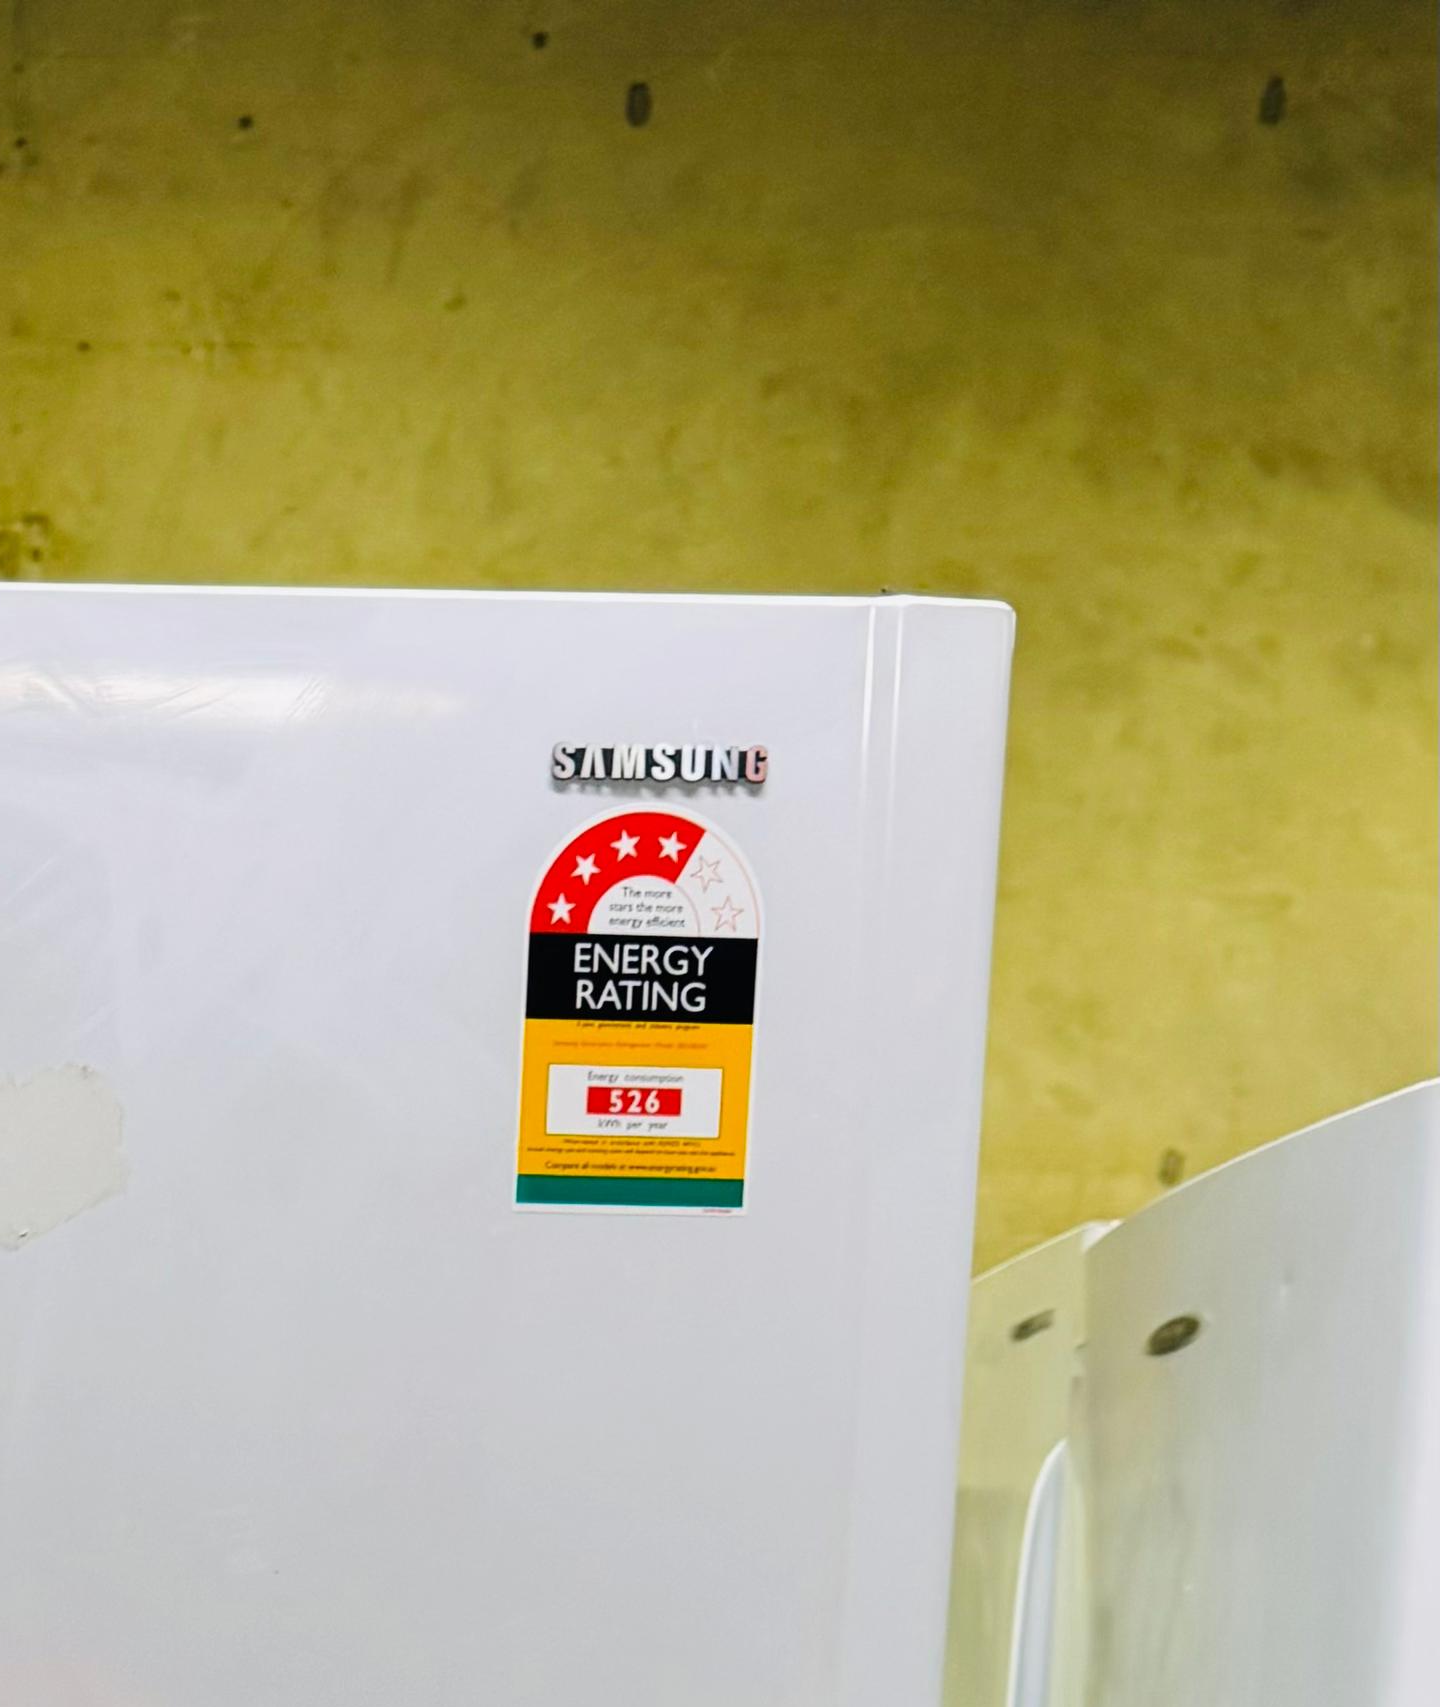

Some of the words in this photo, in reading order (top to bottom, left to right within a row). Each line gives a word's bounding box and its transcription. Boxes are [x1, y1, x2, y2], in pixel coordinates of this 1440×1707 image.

[551, 741, 769, 784] SAMSUNG
[621, 886, 641, 897] The
[644, 890, 672, 899] more
[609, 903, 633, 912] stars
[636, 901, 652, 912] the
[655, 905, 683, 913] more
[608, 917, 642, 929] energy
[573, 942, 714, 977] ENERGY
[575, 978, 707, 1013] RATING
[587, 1071, 619, 1083] Energy
[623, 1073, 684, 1084] consumption
[609, 1088, 661, 1115] 526
[648, 1121, 668, 1131] year
